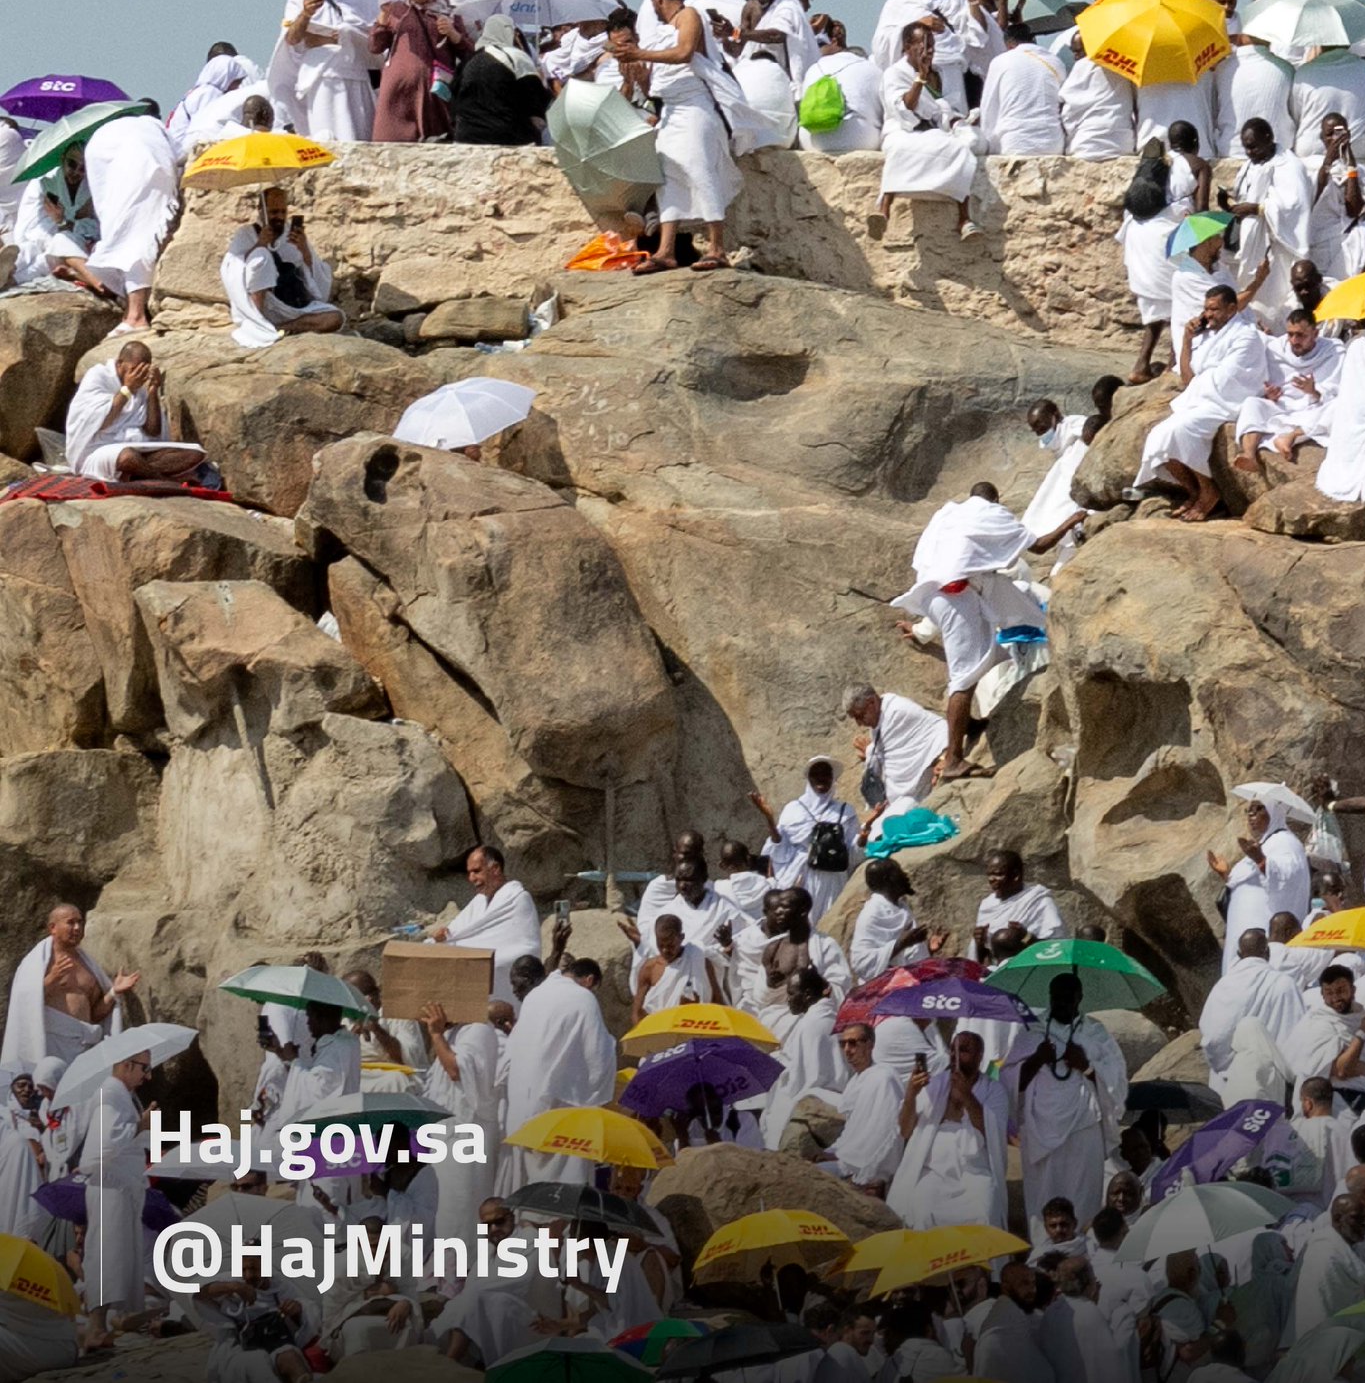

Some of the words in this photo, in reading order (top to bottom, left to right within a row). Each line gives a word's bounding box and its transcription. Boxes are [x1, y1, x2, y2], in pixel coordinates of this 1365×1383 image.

[1103, 48, 1138, 76] DHL
[40, 80, 77, 93] stc
[921, 993, 962, 1011] stc
[679, 1018, 722, 1031] DHL
[650, 1042, 688, 1064] stc
[1242, 1108, 1272, 1134] stc
[550, 1134, 593, 1154] DHL
[928, 1248, 972, 1271] DHL
[14, 1276, 54, 1302] DHL
